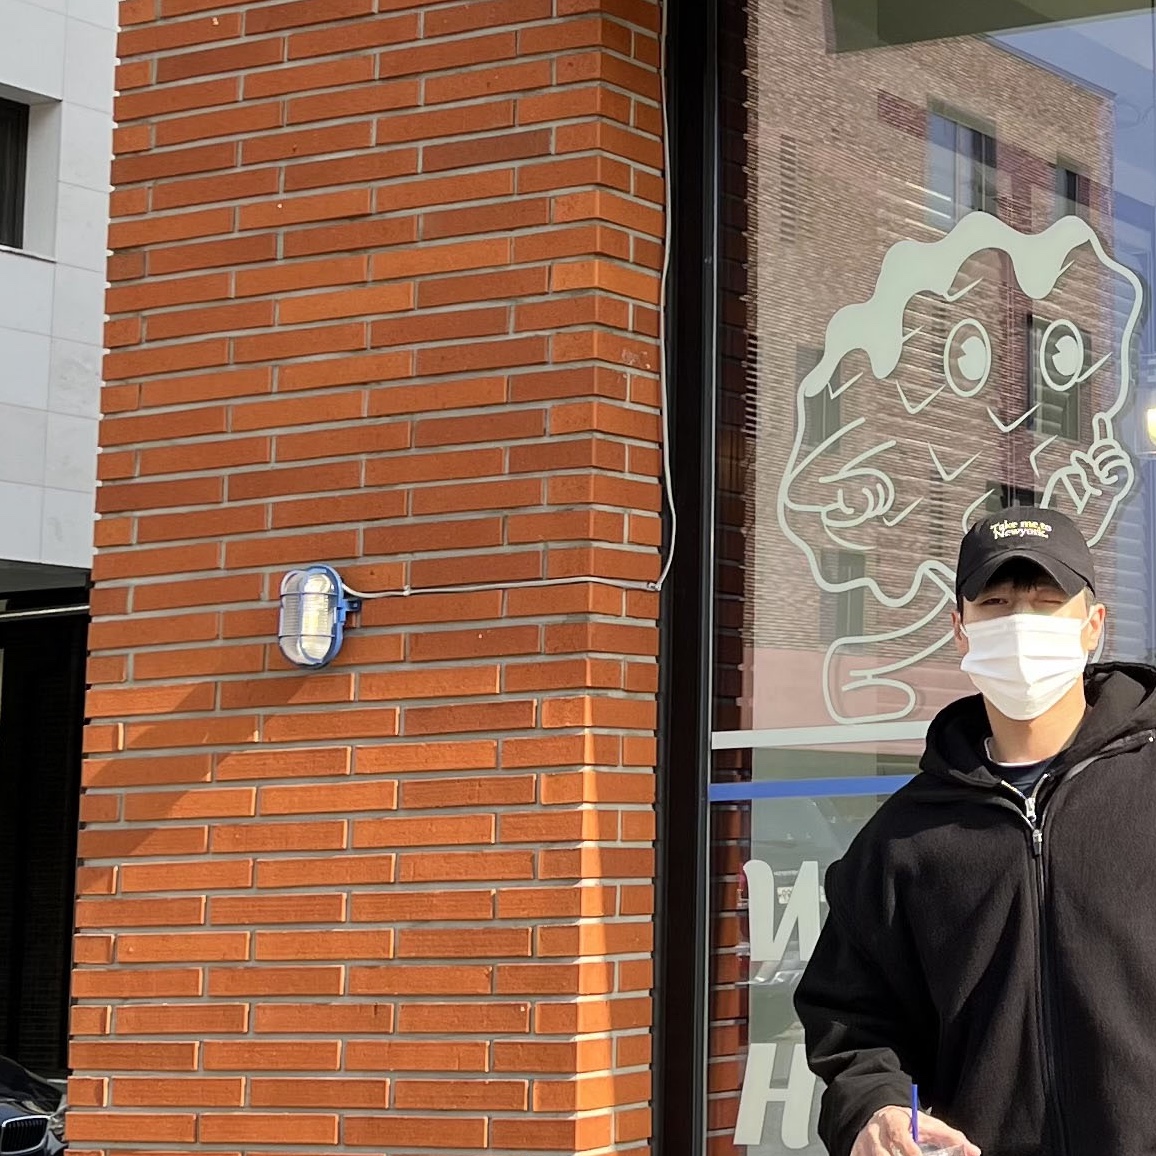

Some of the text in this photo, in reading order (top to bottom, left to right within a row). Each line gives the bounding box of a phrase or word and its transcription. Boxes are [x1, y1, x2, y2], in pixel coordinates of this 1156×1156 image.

[990, 519, 1052, 532] Take me to
